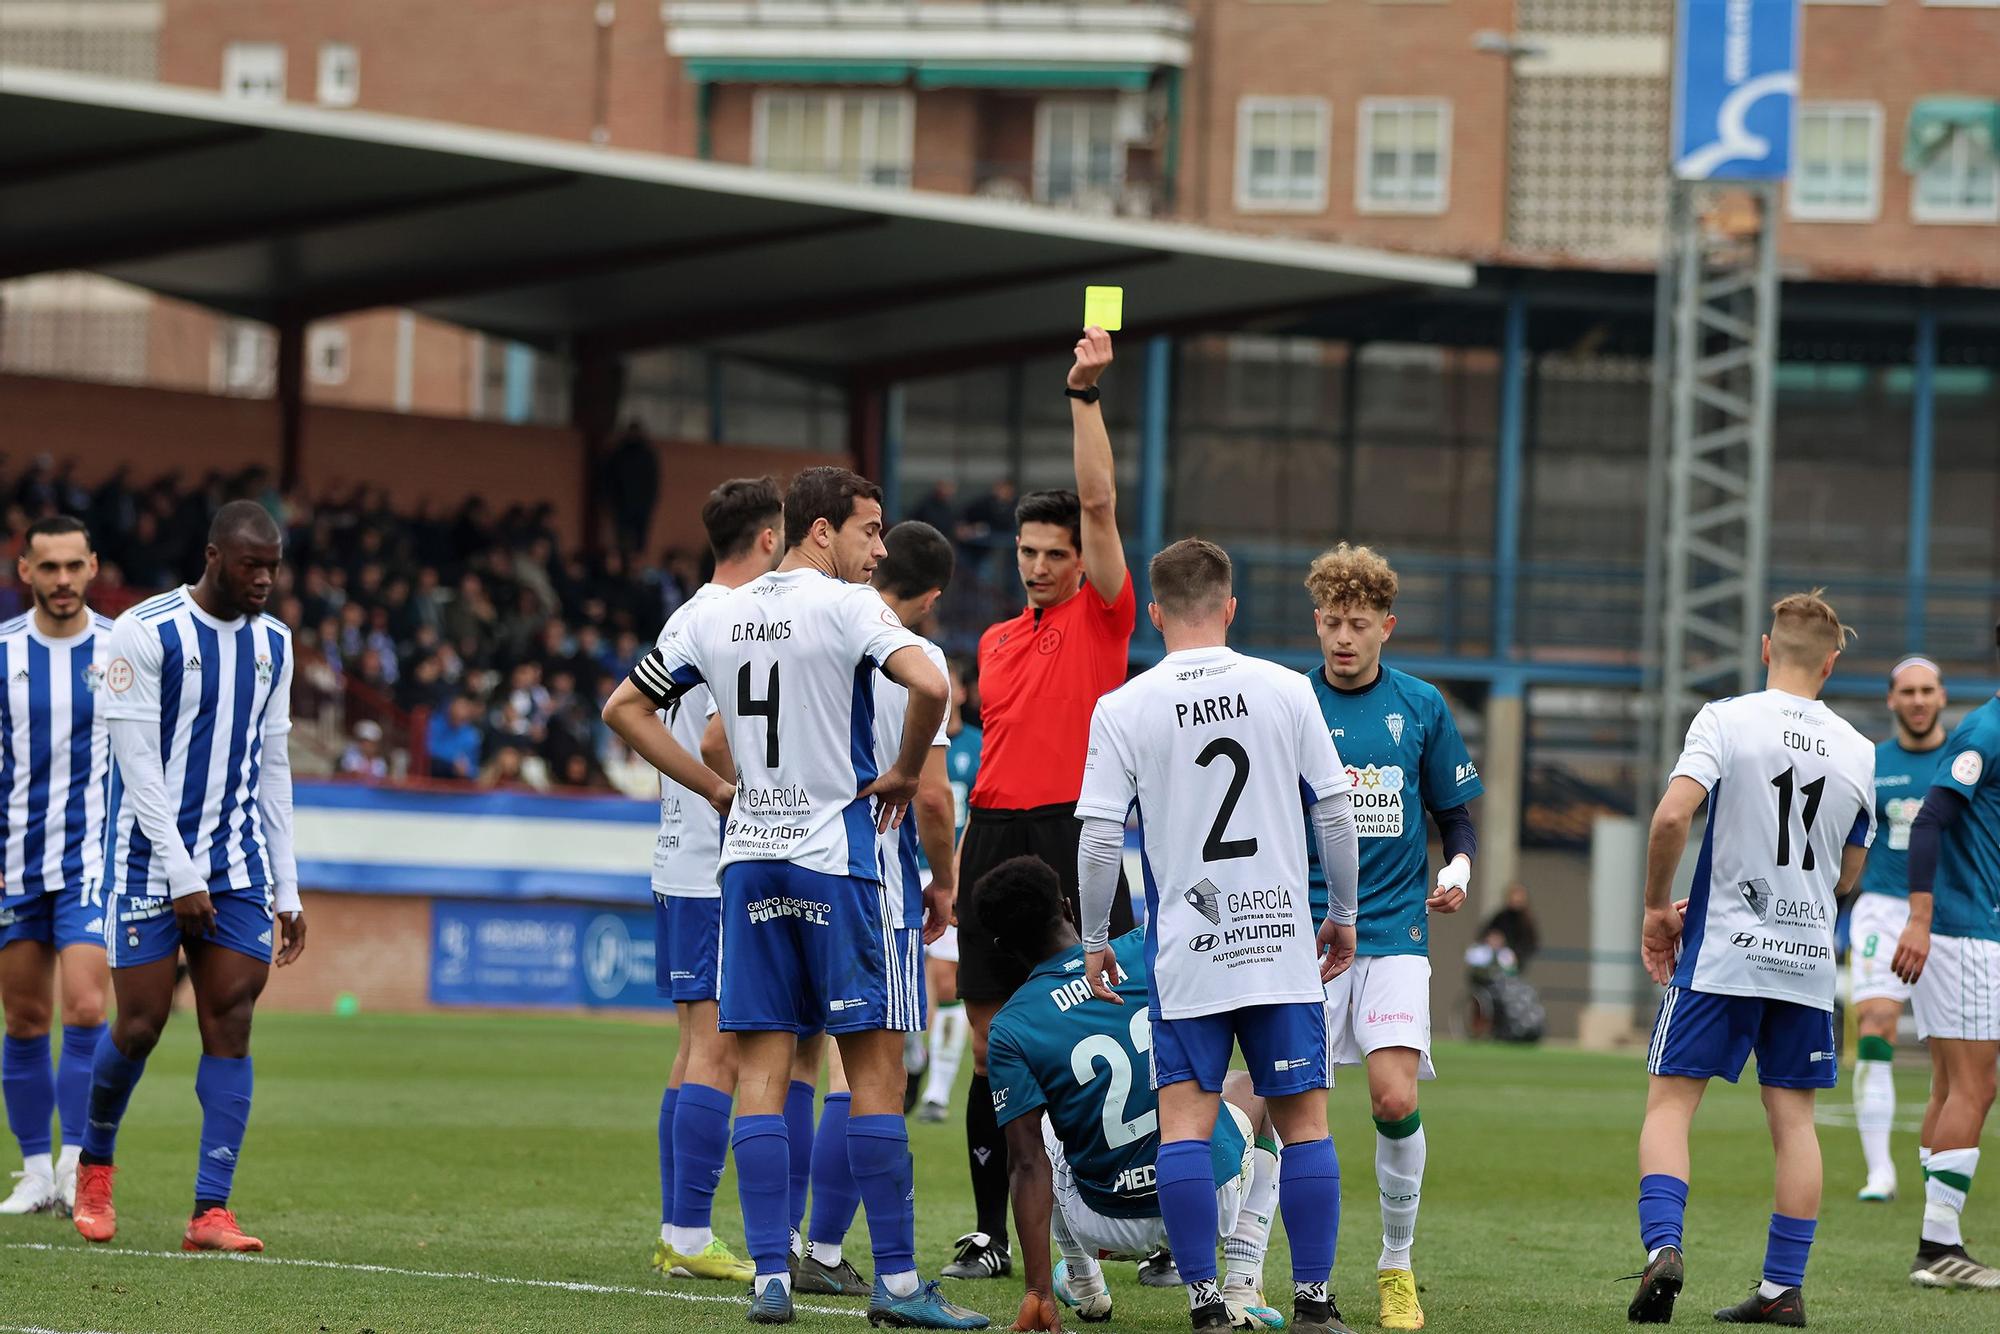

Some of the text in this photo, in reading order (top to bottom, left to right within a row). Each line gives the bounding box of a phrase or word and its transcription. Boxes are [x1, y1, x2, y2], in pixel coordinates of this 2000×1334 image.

[731, 619, 792, 643] D.RAMOS
[737, 659, 780, 769] 4
[1175, 692, 1249, 728] PARRA
[1783, 730, 1830, 758] EDU G.
[748, 784, 810, 808] GARCÍA
[1194, 736, 1258, 863] 2
[1386, 814, 1400, 823] DE
[1770, 765, 1826, 871] 11
[747, 896, 831, 913] GRUPO LOGÍSTICO
[1228, 885, 1292, 914] GARCÍA
[749, 904, 829, 926] PULIDO S.L.
[1231, 913, 1264, 923] INDUSTRIAS
[1224, 923, 1295, 944] HYUNDAI
[1212, 945, 1282, 963] AUTOMOVILES CLM
[1762, 938, 1830, 960] HYUNDAI
[1745, 953, 1816, 971] AUTOMOVILES CLM
